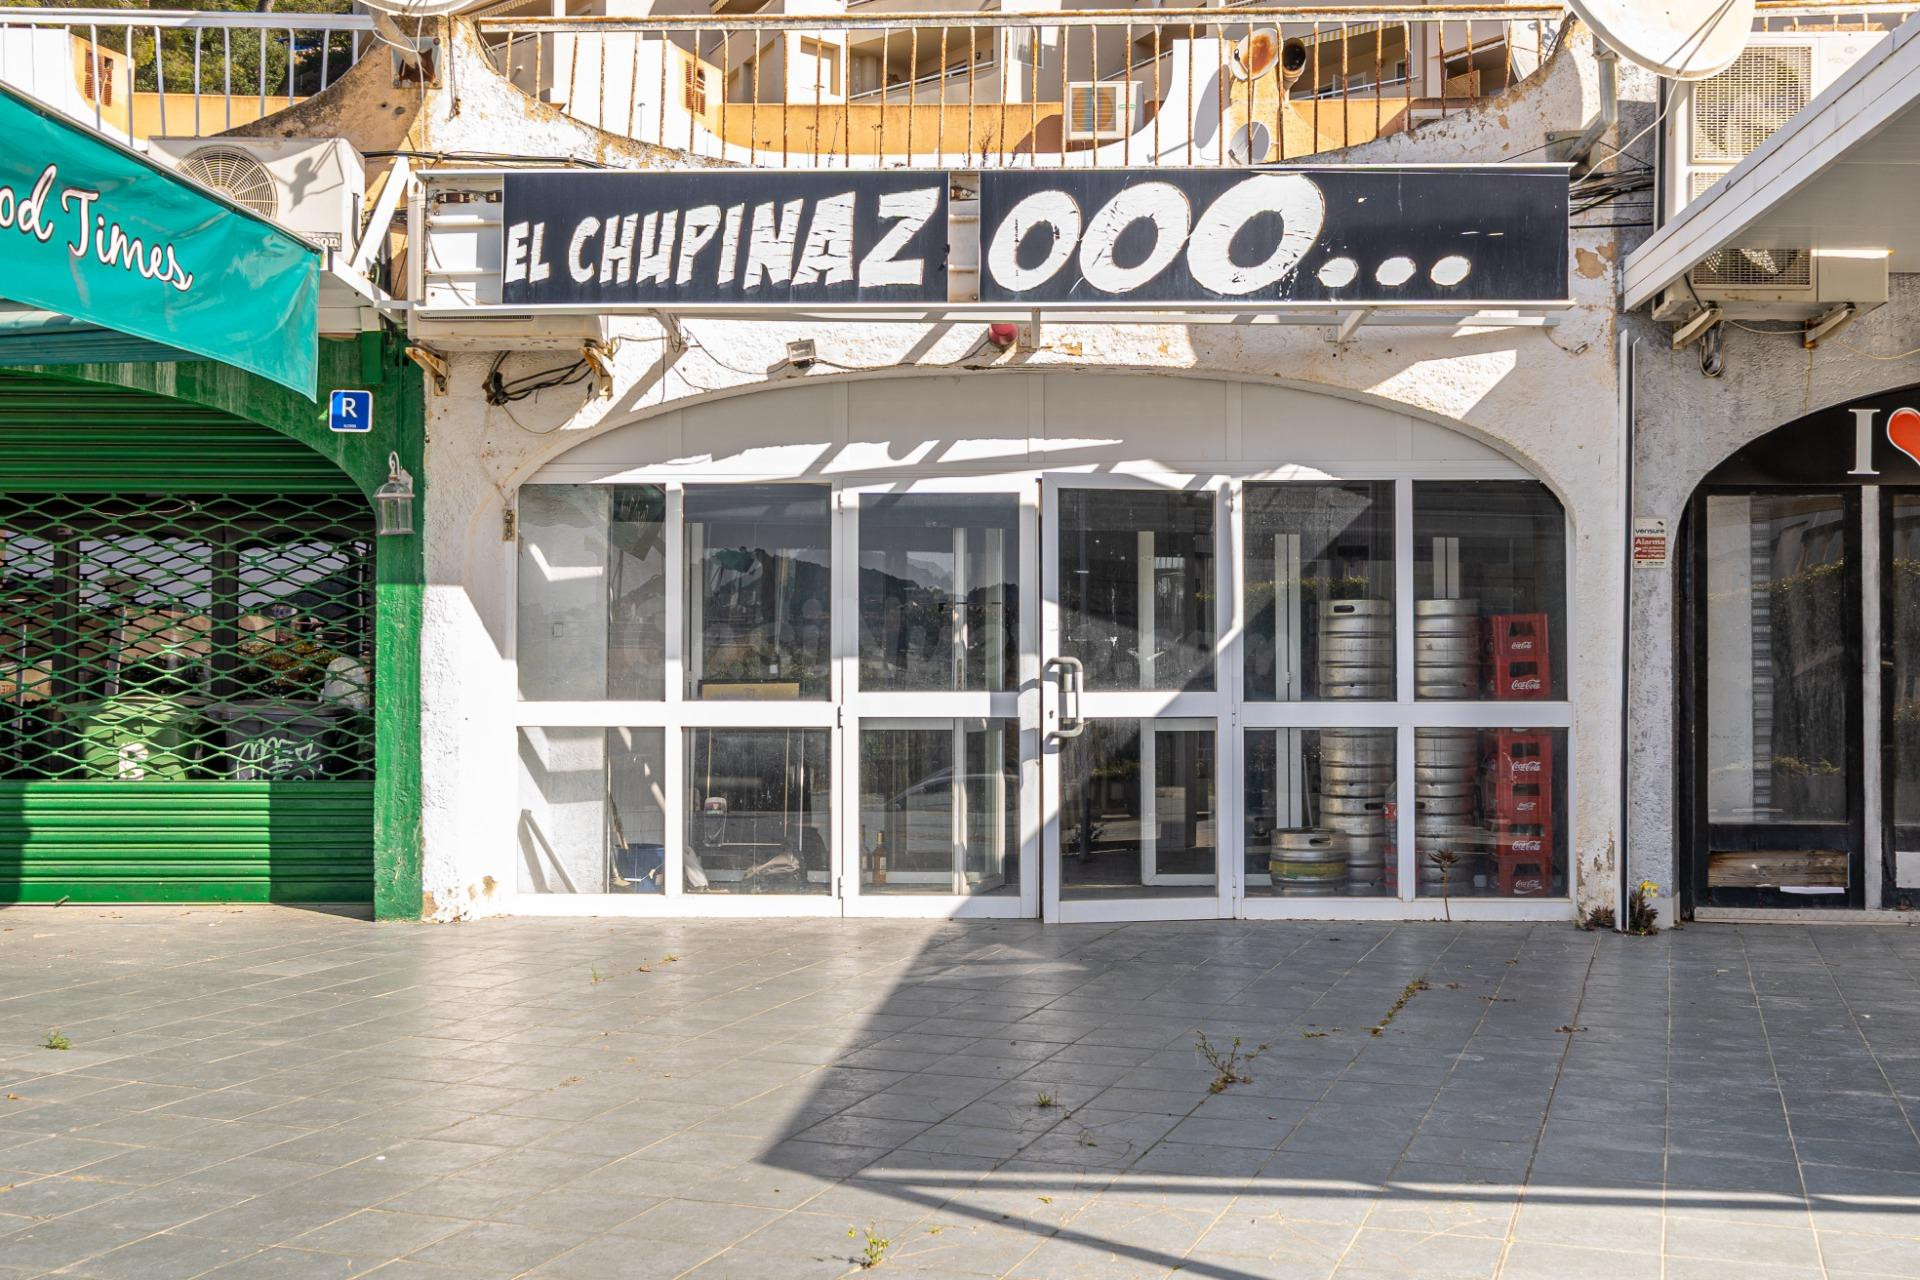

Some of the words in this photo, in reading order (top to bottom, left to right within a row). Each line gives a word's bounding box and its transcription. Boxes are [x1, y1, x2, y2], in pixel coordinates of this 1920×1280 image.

[61, 187, 193, 291] Times
[504, 221, 551, 284] EL
[568, 187, 941, 290] CHUPINAZ
[342, 397, 358, 418] R
[1847, 408, 1881, 475] I
